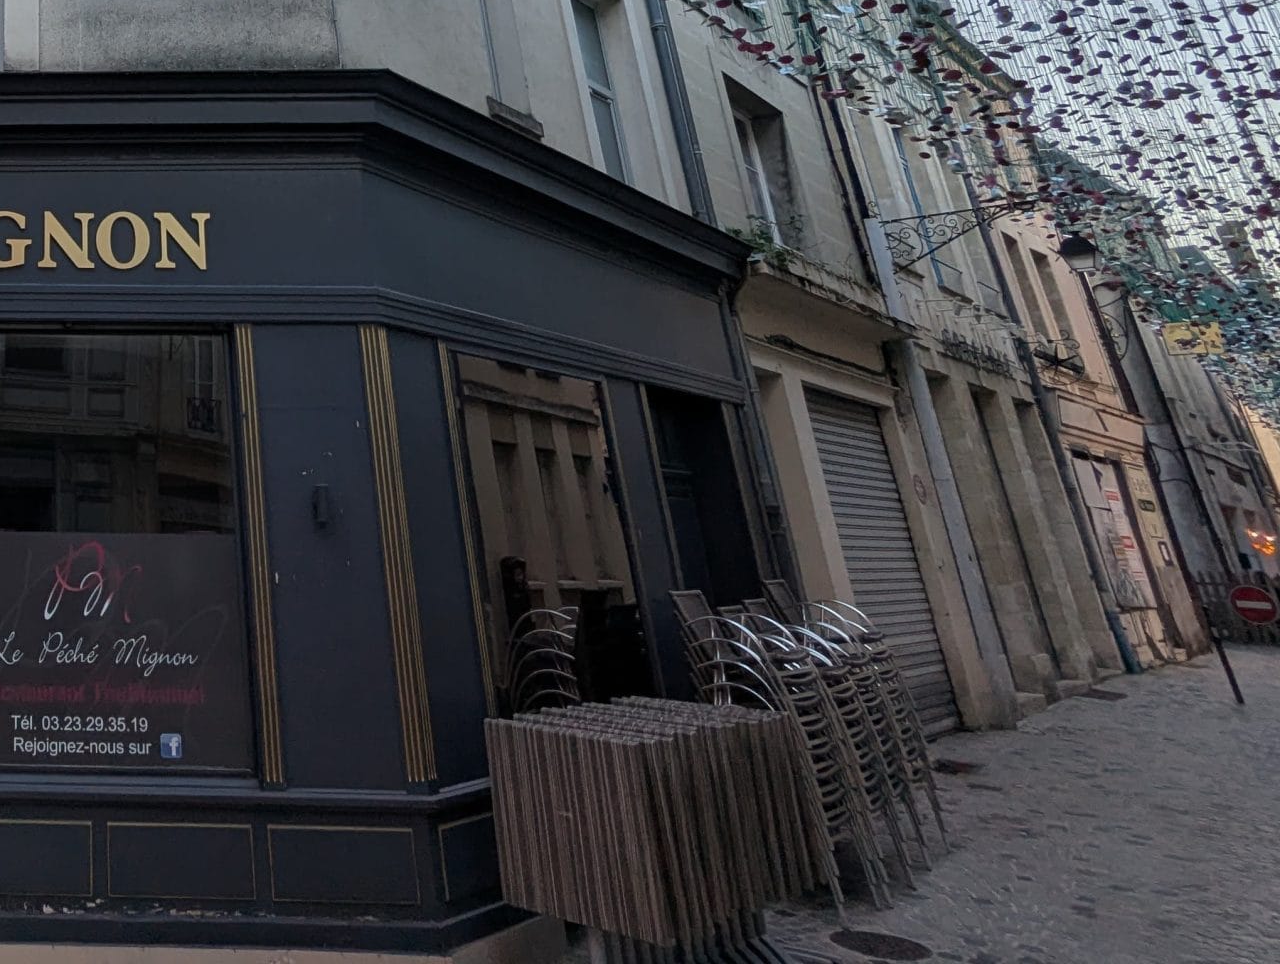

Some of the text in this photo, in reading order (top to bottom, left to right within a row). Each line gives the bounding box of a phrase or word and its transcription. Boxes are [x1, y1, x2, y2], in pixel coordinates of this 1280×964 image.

[38, 632, 99, 665] Péché
[113, 635, 198, 677] Mignon
[11, 715, 149, 733] Tél. 03.23.29.35.19
[13, 737, 124, 756] Rejoignez-nous
[128, 741, 152, 755] sur
